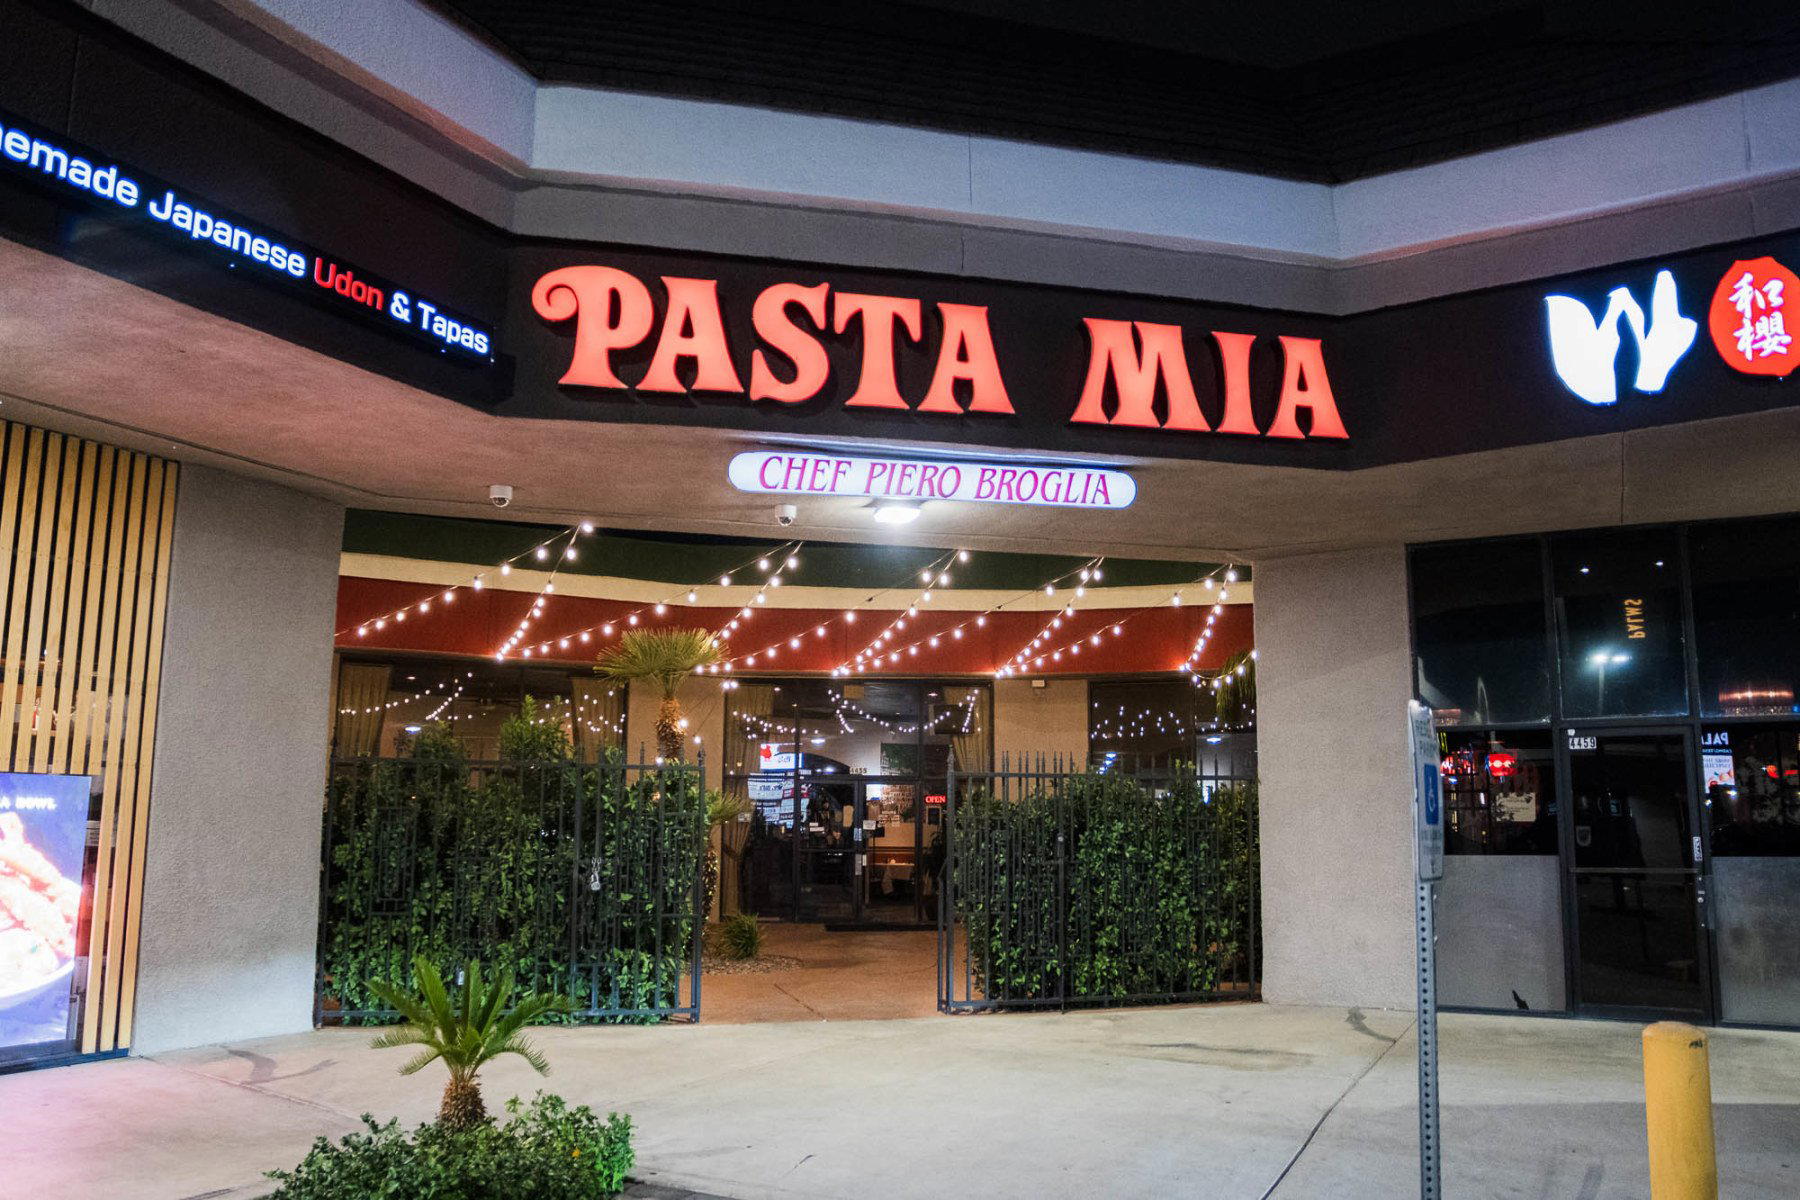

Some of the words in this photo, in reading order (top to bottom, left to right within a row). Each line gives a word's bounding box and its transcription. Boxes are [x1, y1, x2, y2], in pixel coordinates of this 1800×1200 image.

[148, 192, 306, 277] Japanese
[314, 257, 384, 311] Udon
[389, 291, 411, 322] &
[417, 301, 490, 354] Tapas
[531, 265, 1016, 415] PASTA
[1069, 317, 1350, 440] MIA
[758, 456, 852, 494] CHEF
[863, 462, 962, 500] PIERO
[973, 468, 1111, 507] BROGLIA
[1569, 737, 1597, 749] 4459
[925, 795, 946, 803] OPEN
